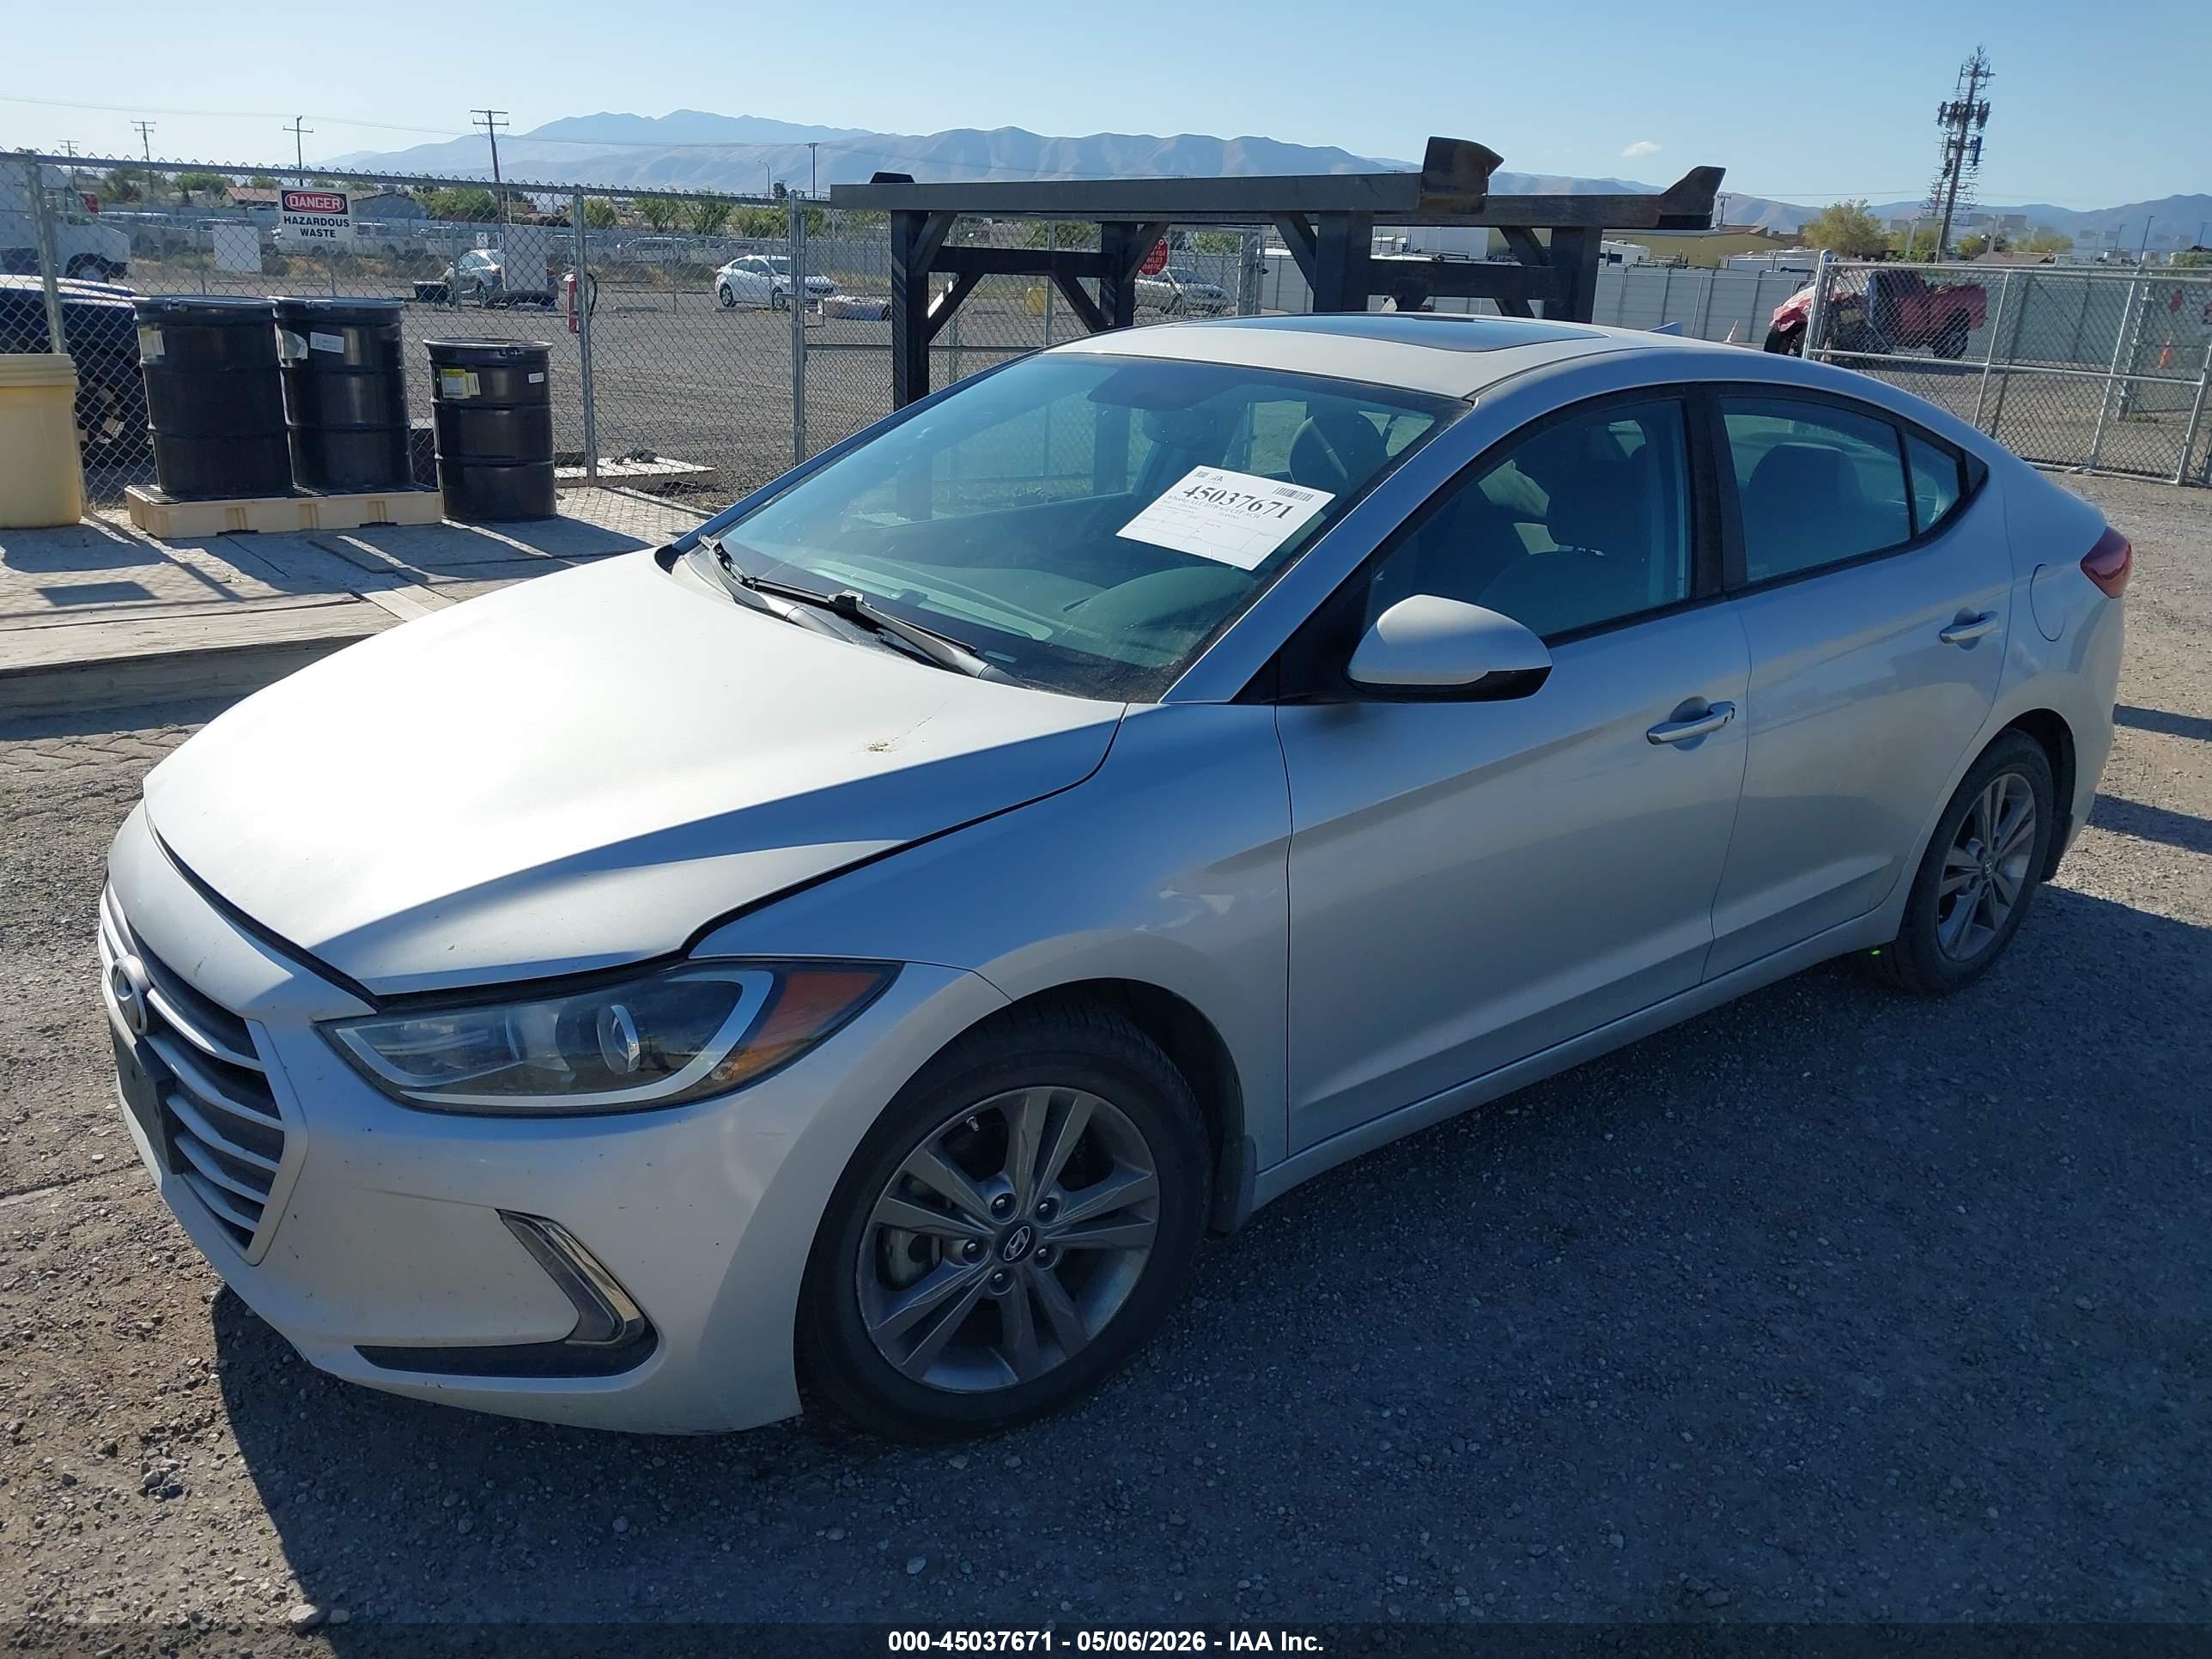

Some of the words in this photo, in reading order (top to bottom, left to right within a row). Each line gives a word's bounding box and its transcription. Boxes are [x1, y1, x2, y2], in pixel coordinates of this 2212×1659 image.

[289, 196, 341, 210] DANGER
[283, 216, 349, 228] HAZARDOUS
[300, 228, 336, 238] WASTE
[1182, 484, 1295, 520] 45037671
